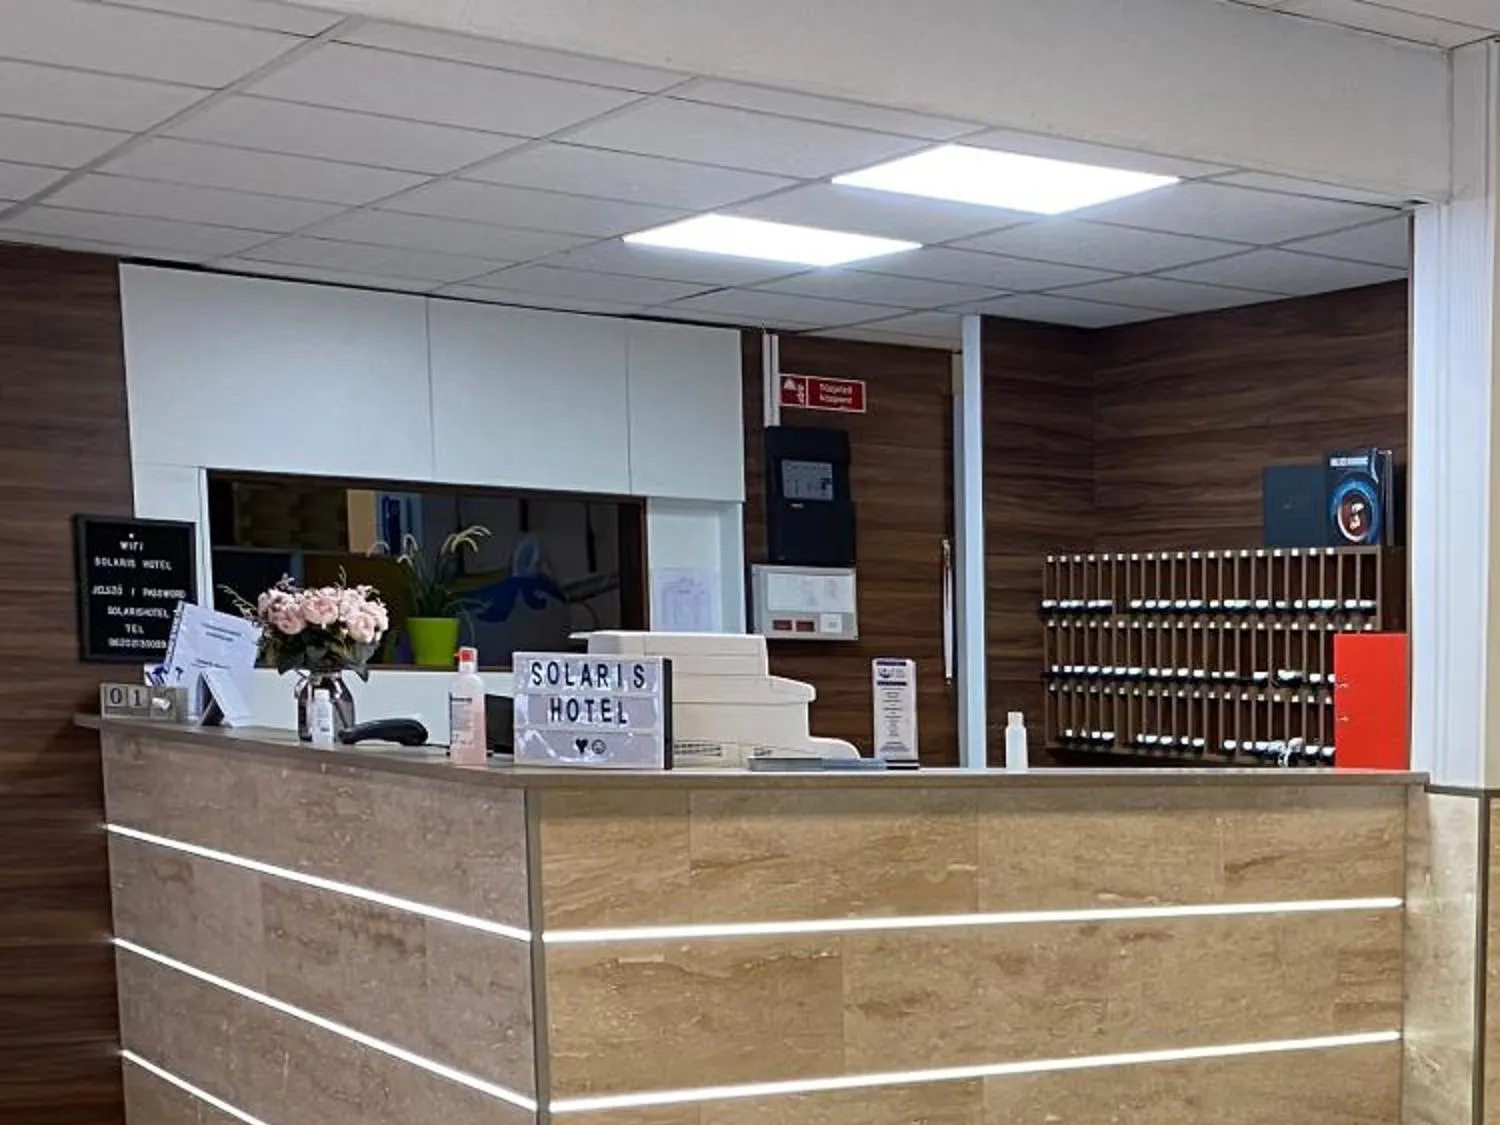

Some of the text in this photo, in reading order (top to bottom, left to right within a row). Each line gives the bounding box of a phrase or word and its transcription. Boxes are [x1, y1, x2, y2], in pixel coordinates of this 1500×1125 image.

[94, 556, 173, 571] SOLARIS HOTEL
[531, 661, 646, 689] SOLARIS
[550, 697, 628, 724] HOTEL
